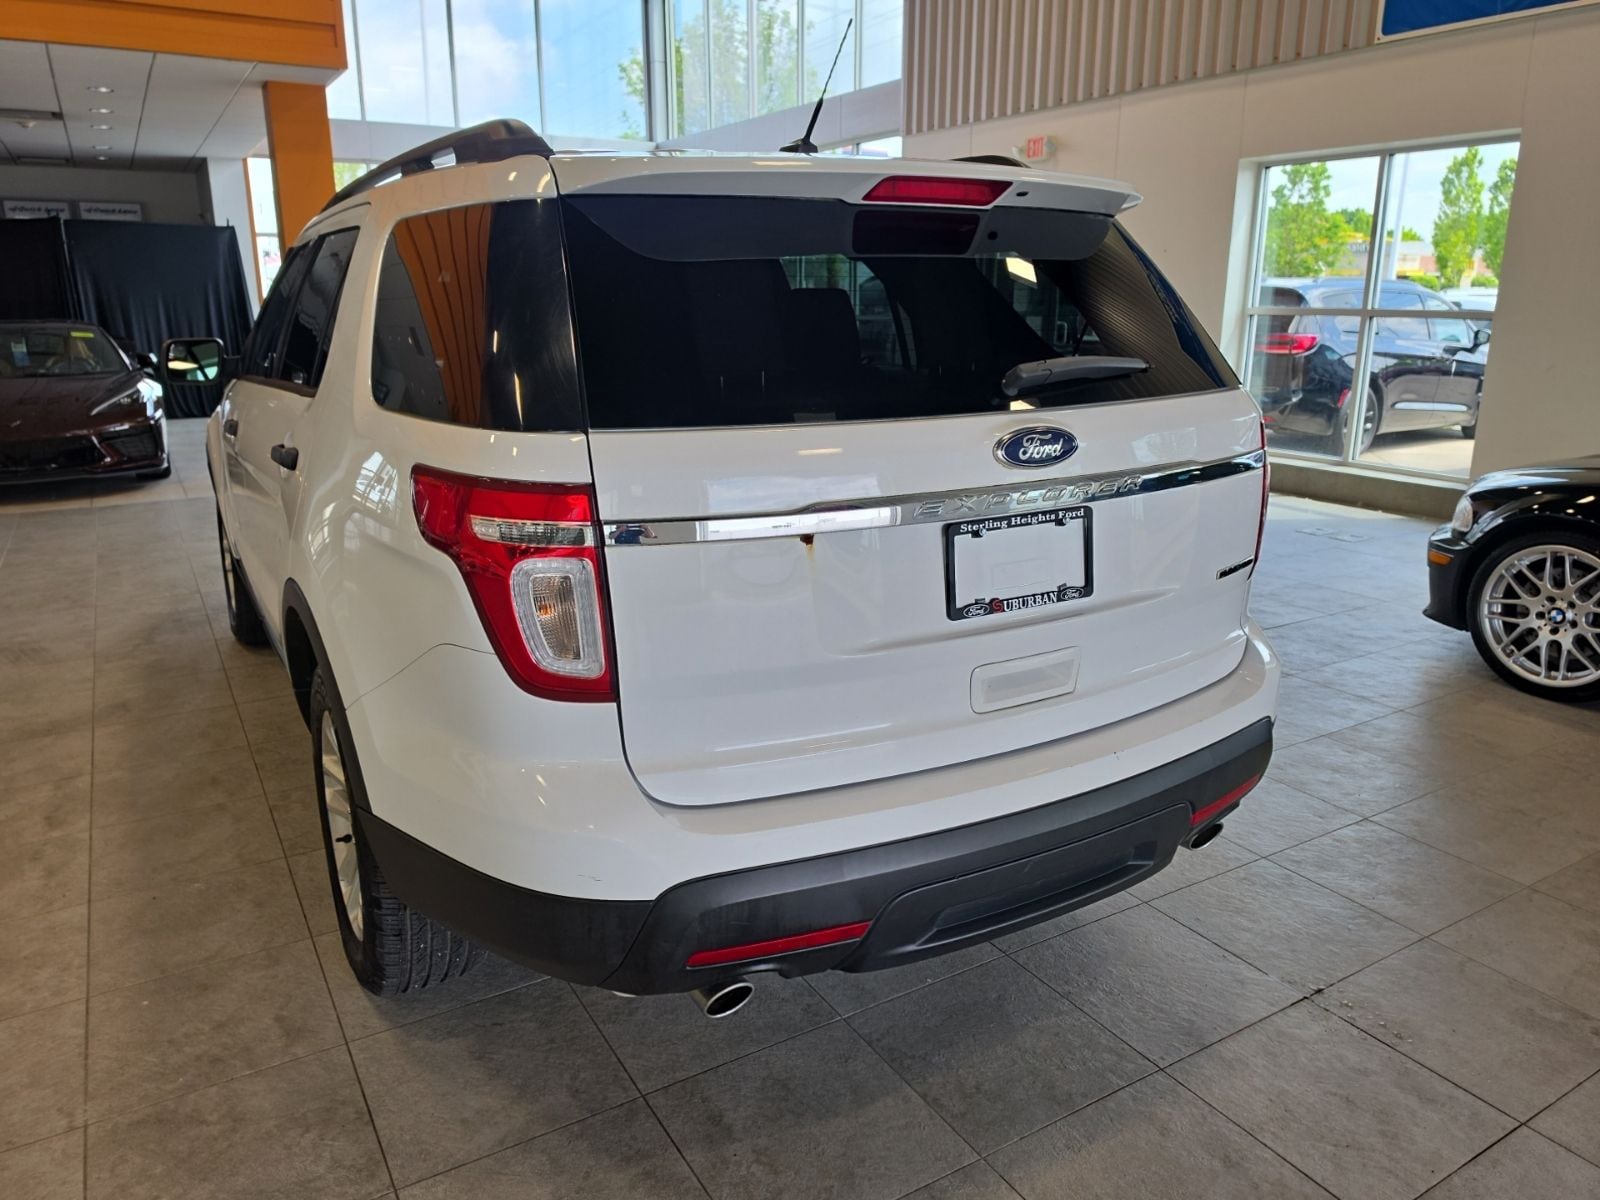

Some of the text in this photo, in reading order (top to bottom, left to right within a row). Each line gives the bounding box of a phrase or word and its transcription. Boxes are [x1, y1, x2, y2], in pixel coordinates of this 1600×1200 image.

[1018, 433, 1064, 461] Ford
[913, 474, 1143, 519] EXPLORER
[960, 508, 1085, 533] Sterling Heights Ford
[967, 588, 1081, 615] Ford SUBURBAN Ford
